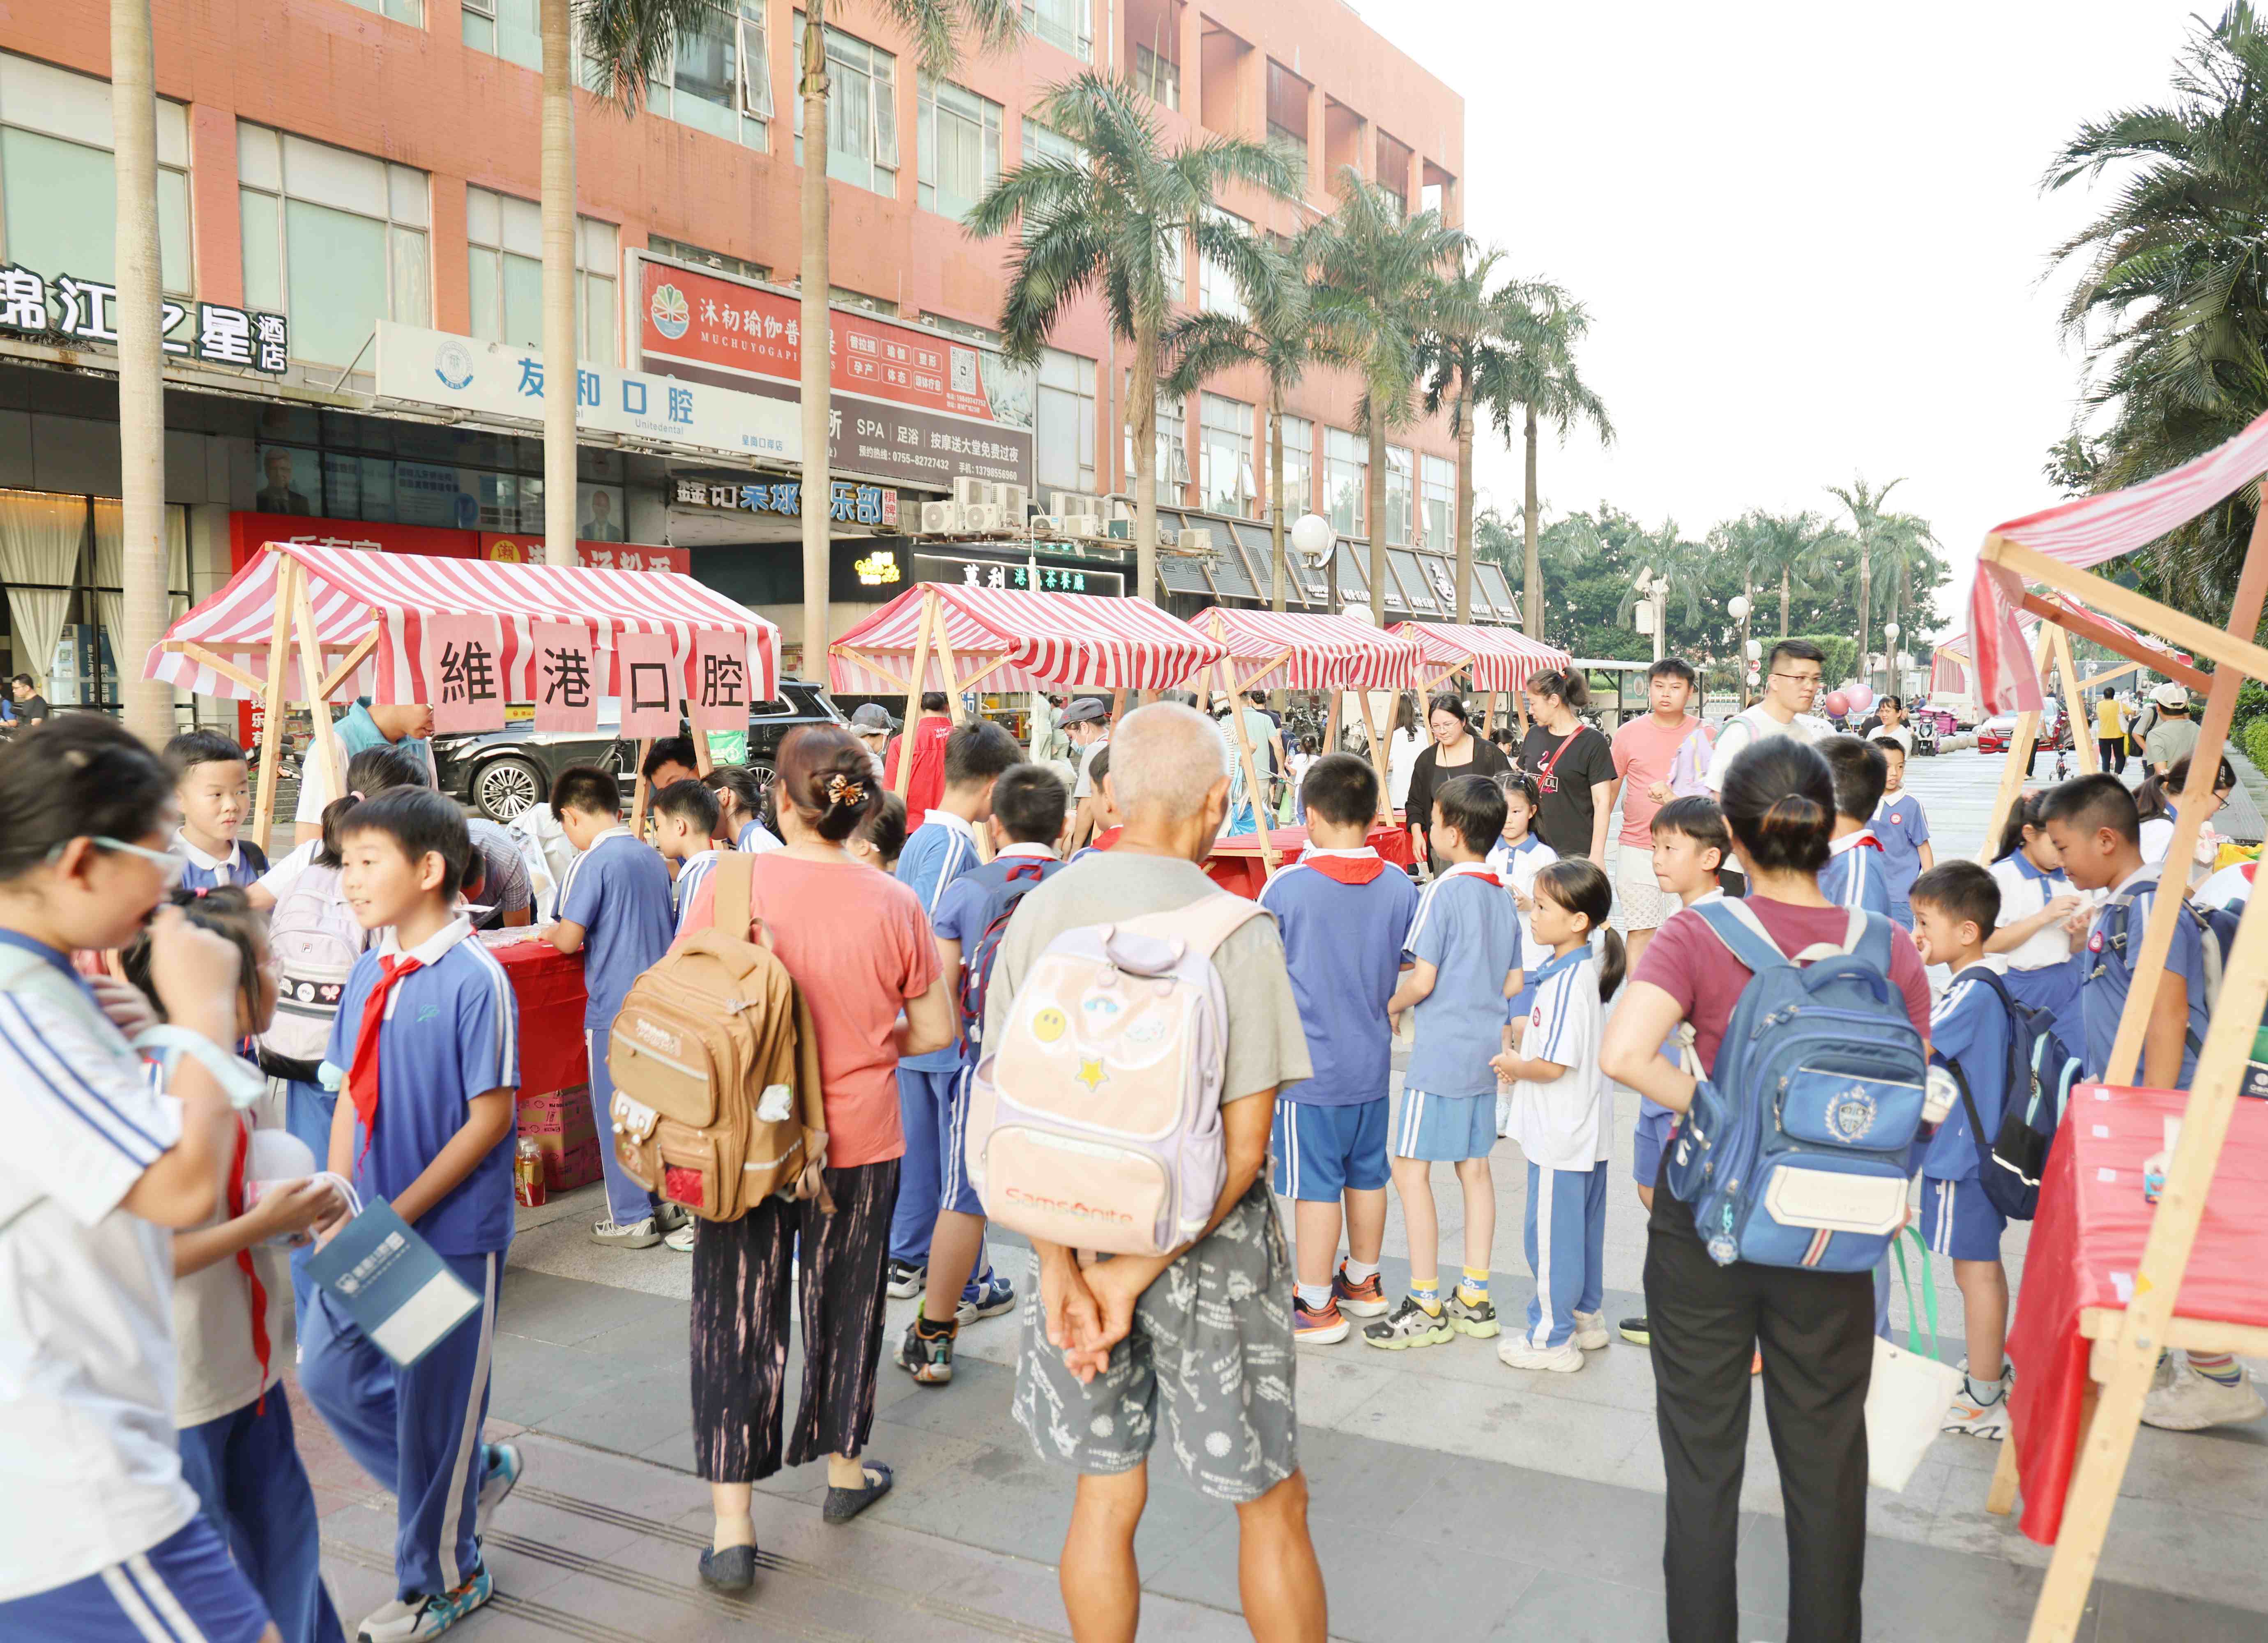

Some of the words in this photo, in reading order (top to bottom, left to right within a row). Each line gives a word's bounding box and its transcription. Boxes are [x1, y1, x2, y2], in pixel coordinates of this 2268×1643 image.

[259, 314, 286, 370] 酒店
[850, 335, 876, 353] 普拉提
[887, 345, 906, 360] 瑜伽
[919, 352, 937, 367] 塑形
[854, 360, 873, 375] 孕产
[887, 368, 906, 384] 体态
[518, 358, 694, 425] 友和口腔
[635, 419, 684, 435] Unitedental
[857, 418, 884, 439] SPA
[897, 426, 919, 446] 足浴
[931, 431, 1019, 463] 按摩送大堂免费过夜
[440, 640, 744, 713] 維港口腔
